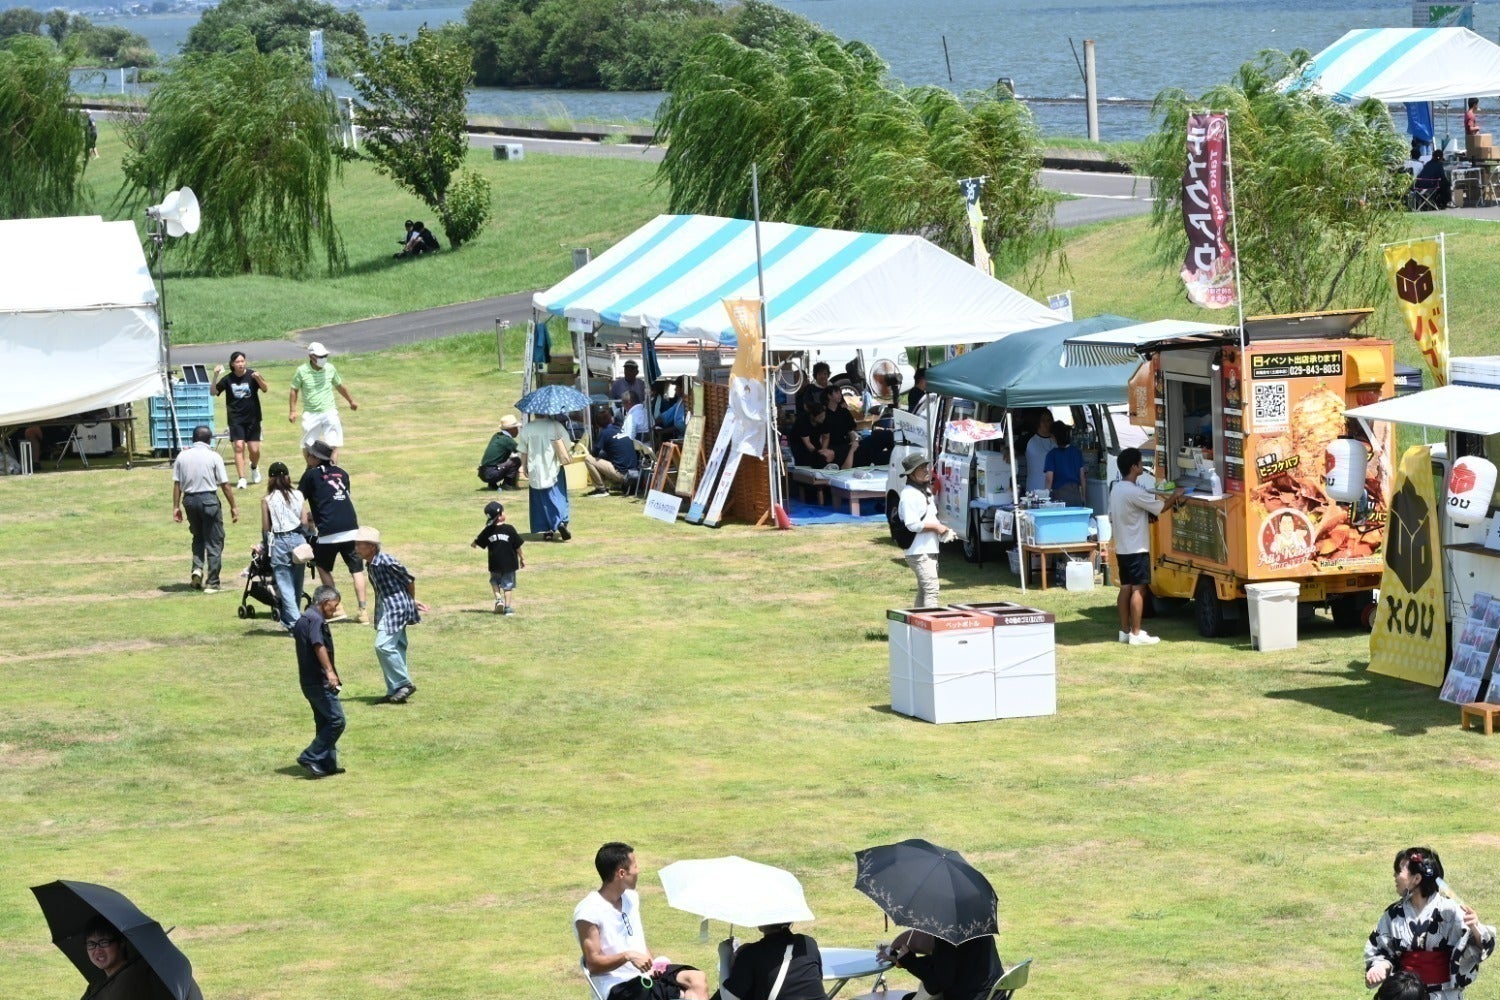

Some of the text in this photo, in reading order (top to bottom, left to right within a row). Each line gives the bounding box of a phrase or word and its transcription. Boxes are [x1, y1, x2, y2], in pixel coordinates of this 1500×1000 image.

[1289, 364, 1341, 375] 029-843-8033
[1386, 595, 1435, 641] KOU
[945, 620, 980, 629] ペットボトル
